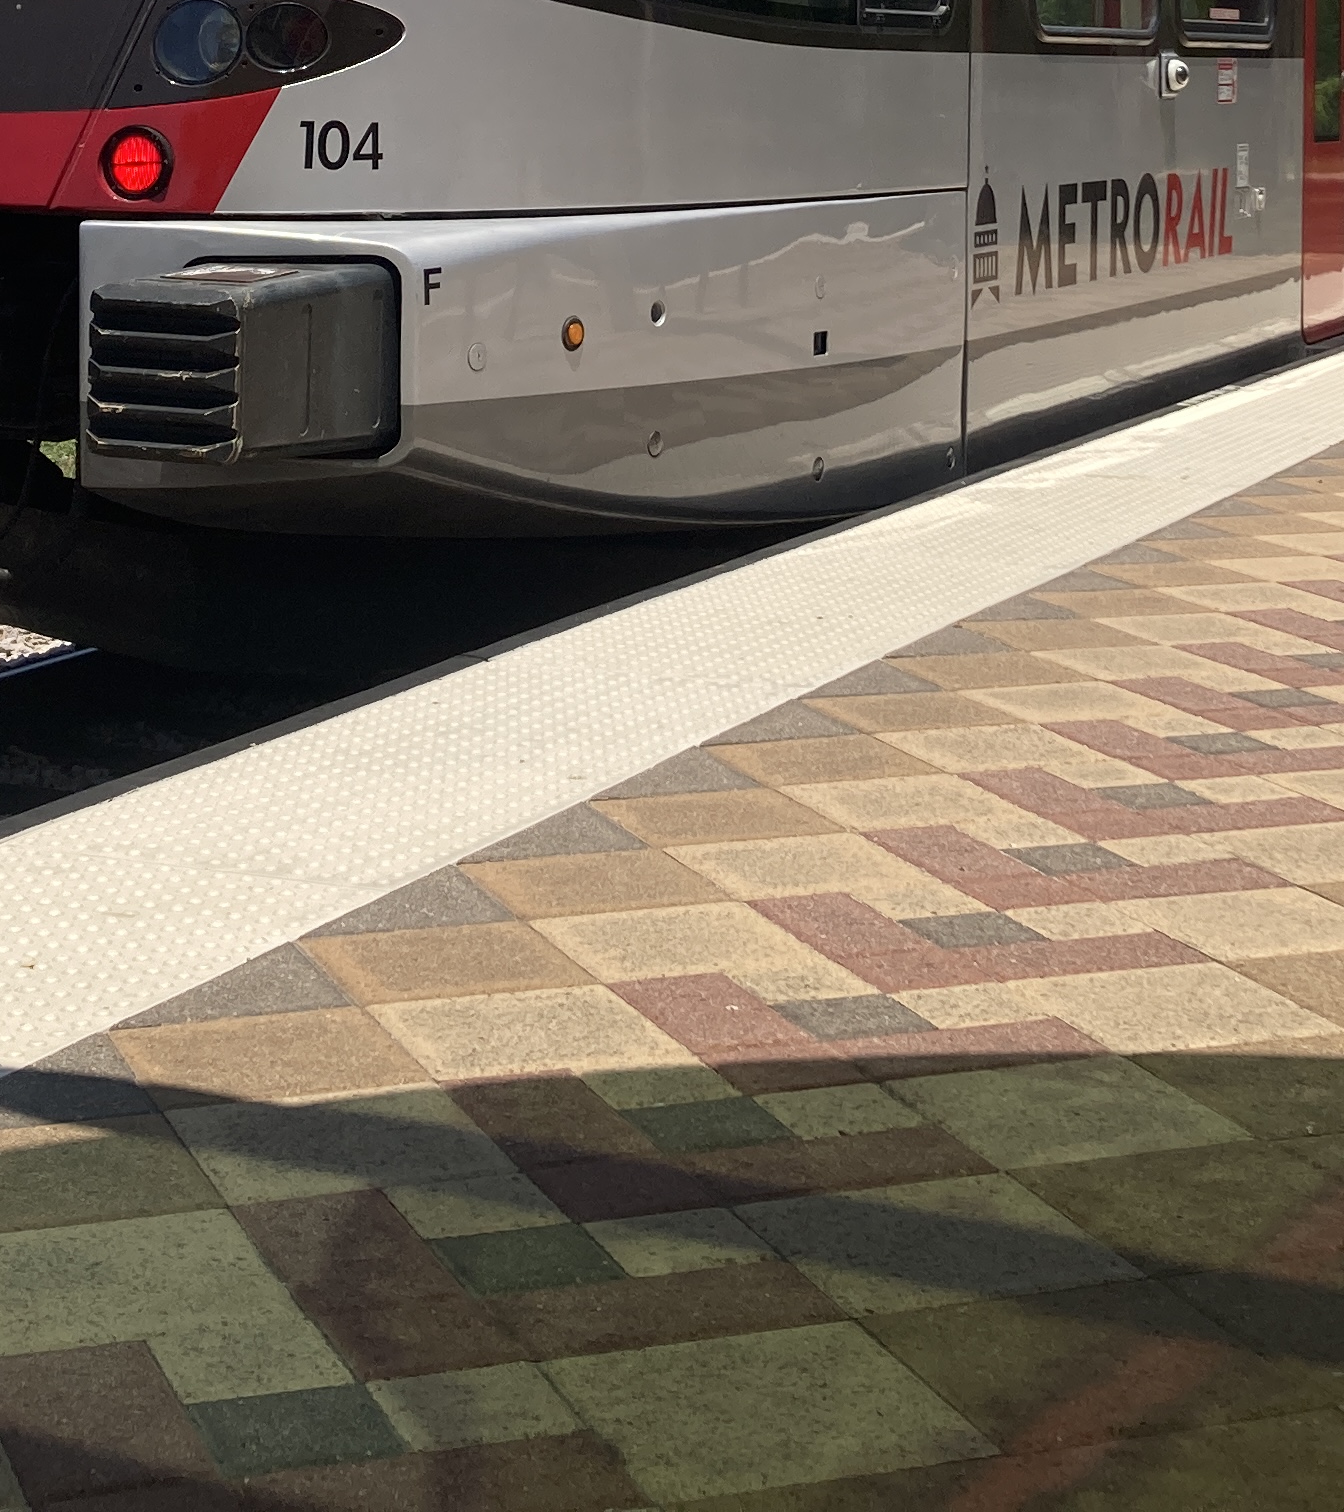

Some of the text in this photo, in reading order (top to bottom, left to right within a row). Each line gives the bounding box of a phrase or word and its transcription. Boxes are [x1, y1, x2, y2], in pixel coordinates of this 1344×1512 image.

[299, 120, 384, 170] 104
[1014, 167, 1233, 295] METRORAIL
[423, 267, 442, 305] F
